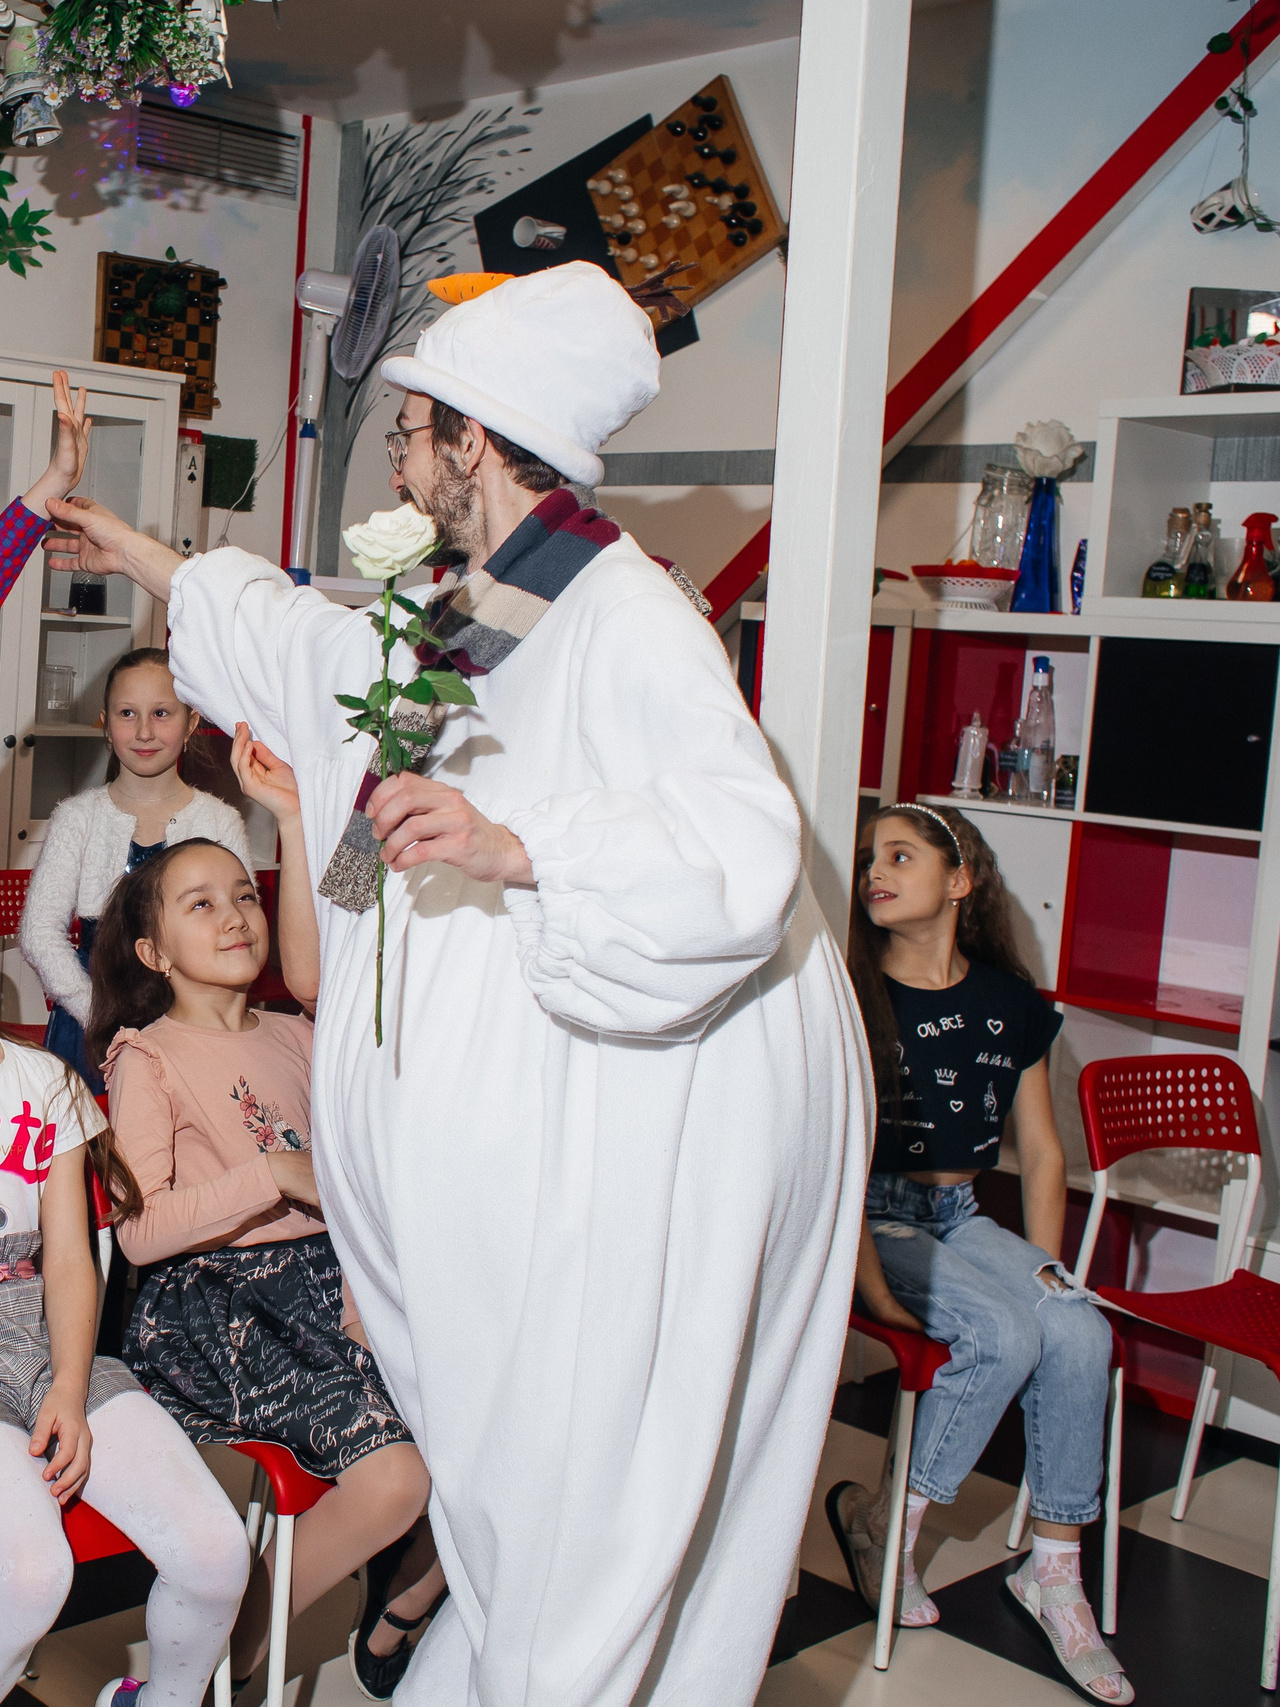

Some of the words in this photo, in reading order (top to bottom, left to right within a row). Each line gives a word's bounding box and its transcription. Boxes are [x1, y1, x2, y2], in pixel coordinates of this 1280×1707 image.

[187, 455, 197, 470] A
[975, 1052, 989, 1064] bla
[989, 1054, 1002, 1067] bla
[338, 1429, 403, 1470] beautiful
